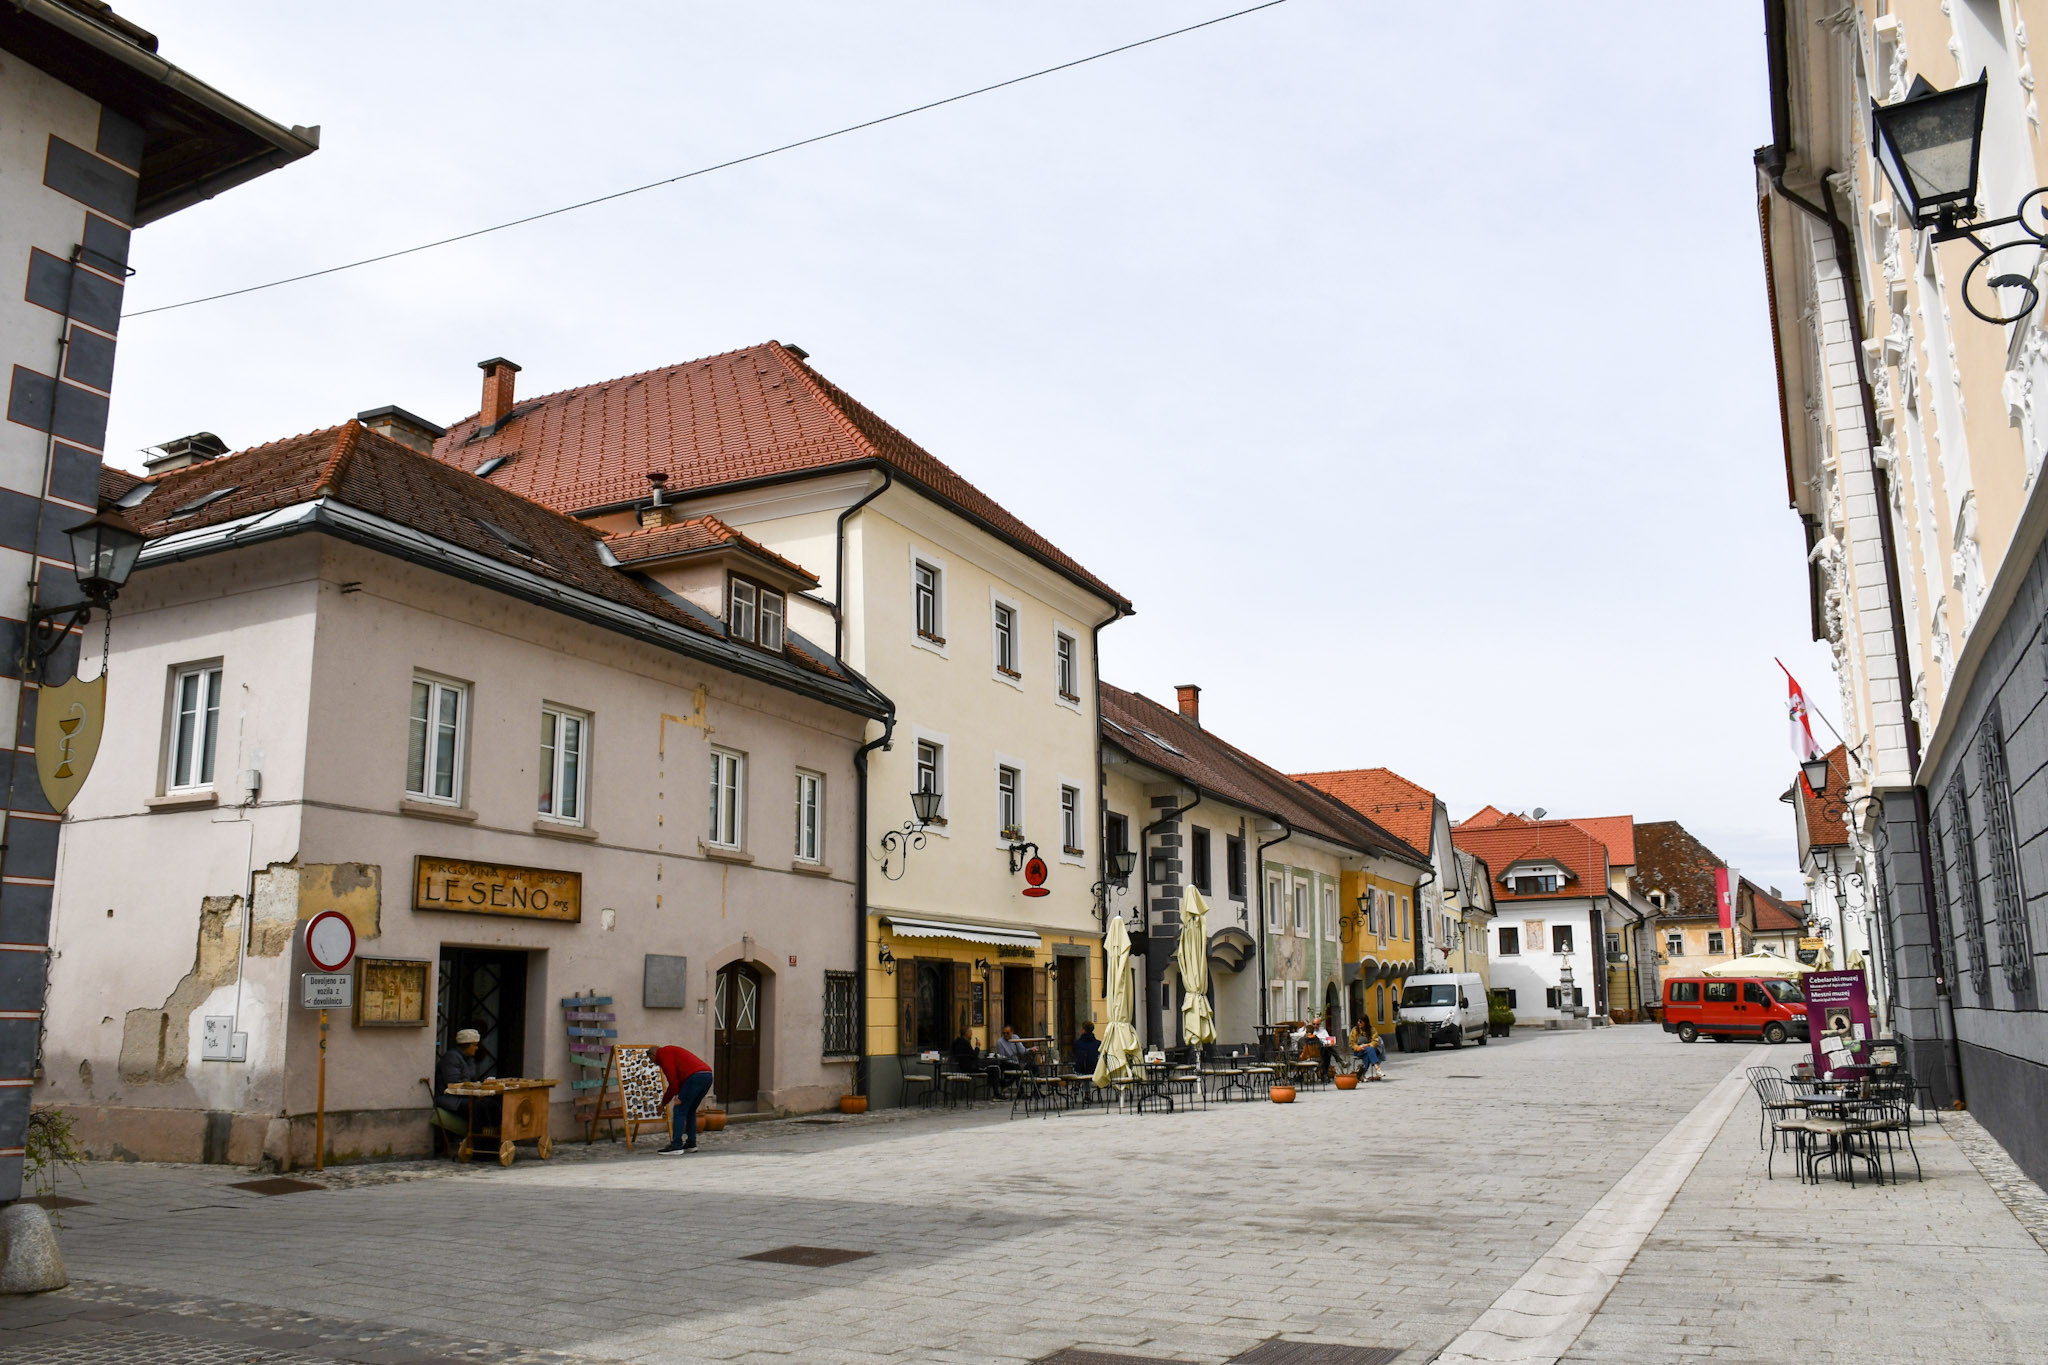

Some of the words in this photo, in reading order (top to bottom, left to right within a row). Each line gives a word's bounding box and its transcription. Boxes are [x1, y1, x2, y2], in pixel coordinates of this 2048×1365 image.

[428, 863, 500, 878] TRGOVINA
[506, 871, 533, 882] GIFT
[537, 873, 569, 886] SHOP
[424, 876, 549, 911] LESENO
[310, 977, 336, 986] Dovoljeno
[317, 987, 333, 995] vozila
